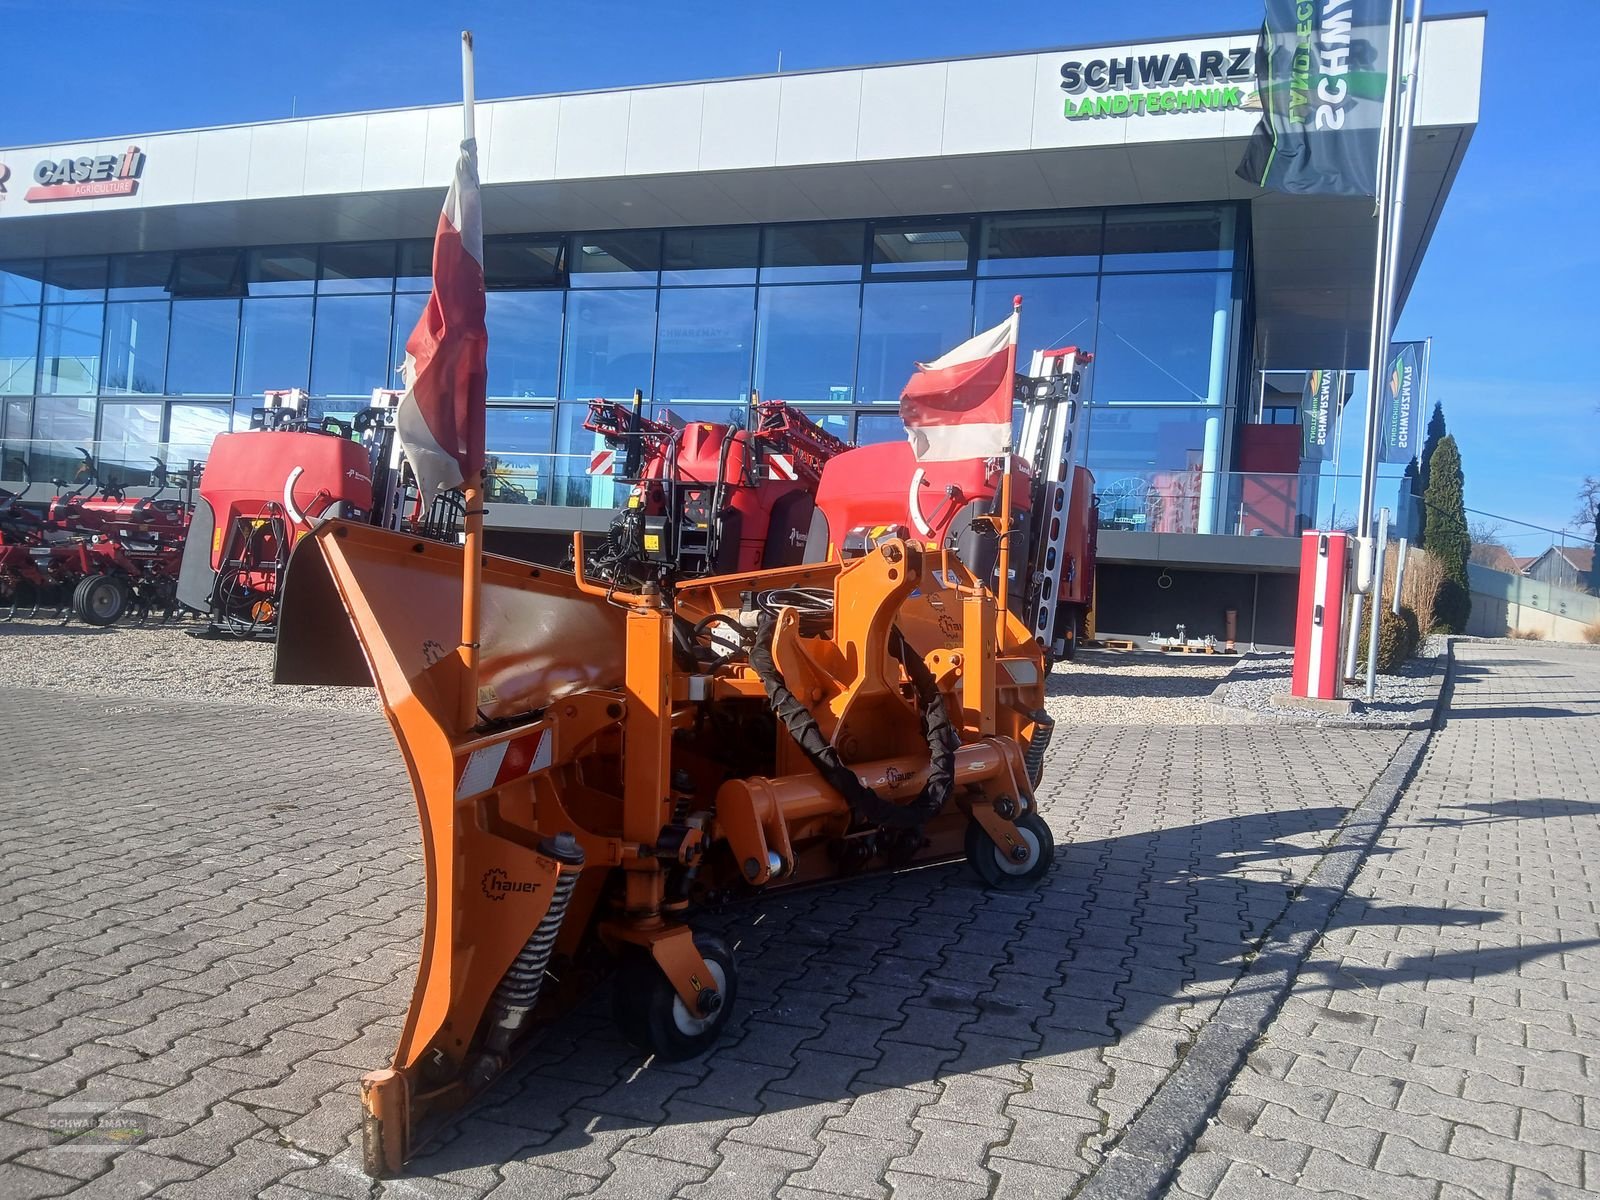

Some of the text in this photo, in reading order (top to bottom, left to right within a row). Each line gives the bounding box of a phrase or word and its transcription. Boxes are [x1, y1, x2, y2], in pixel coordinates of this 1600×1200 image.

[1060, 48, 1257, 91] SCHWARZ
[1063, 87, 1240, 118] LANDTECHNIK
[75, 182, 130, 195] AGRICULTURE
[491, 876, 541, 893] hauer
